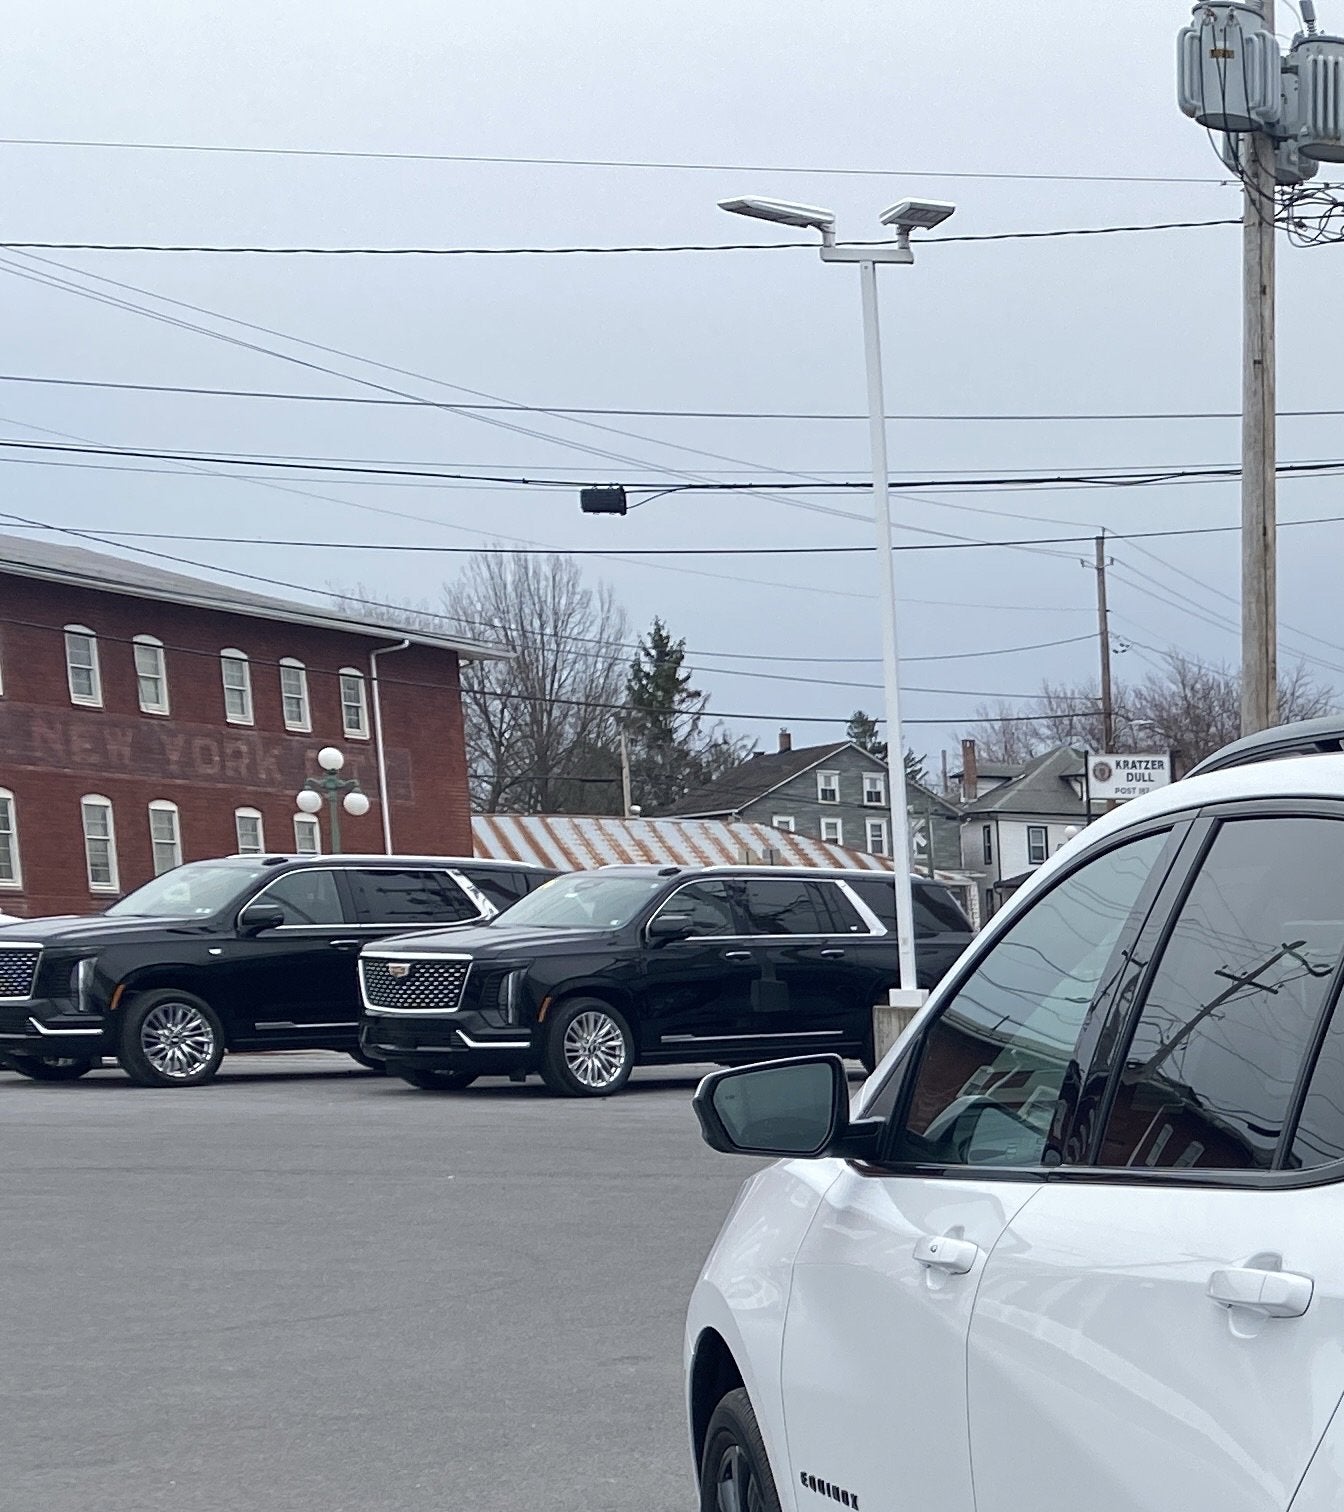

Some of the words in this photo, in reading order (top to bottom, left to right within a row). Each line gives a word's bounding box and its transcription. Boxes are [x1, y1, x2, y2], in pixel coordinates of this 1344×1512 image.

[31, 718, 133, 763] NEW
[160, 733, 283, 780] YORK
[1115, 760, 1165, 770] KRATZER
[1126, 772, 1155, 783] DULL
[1114, 787, 1137, 795] POST
[800, 1471, 859, 1511] EQUINOX
